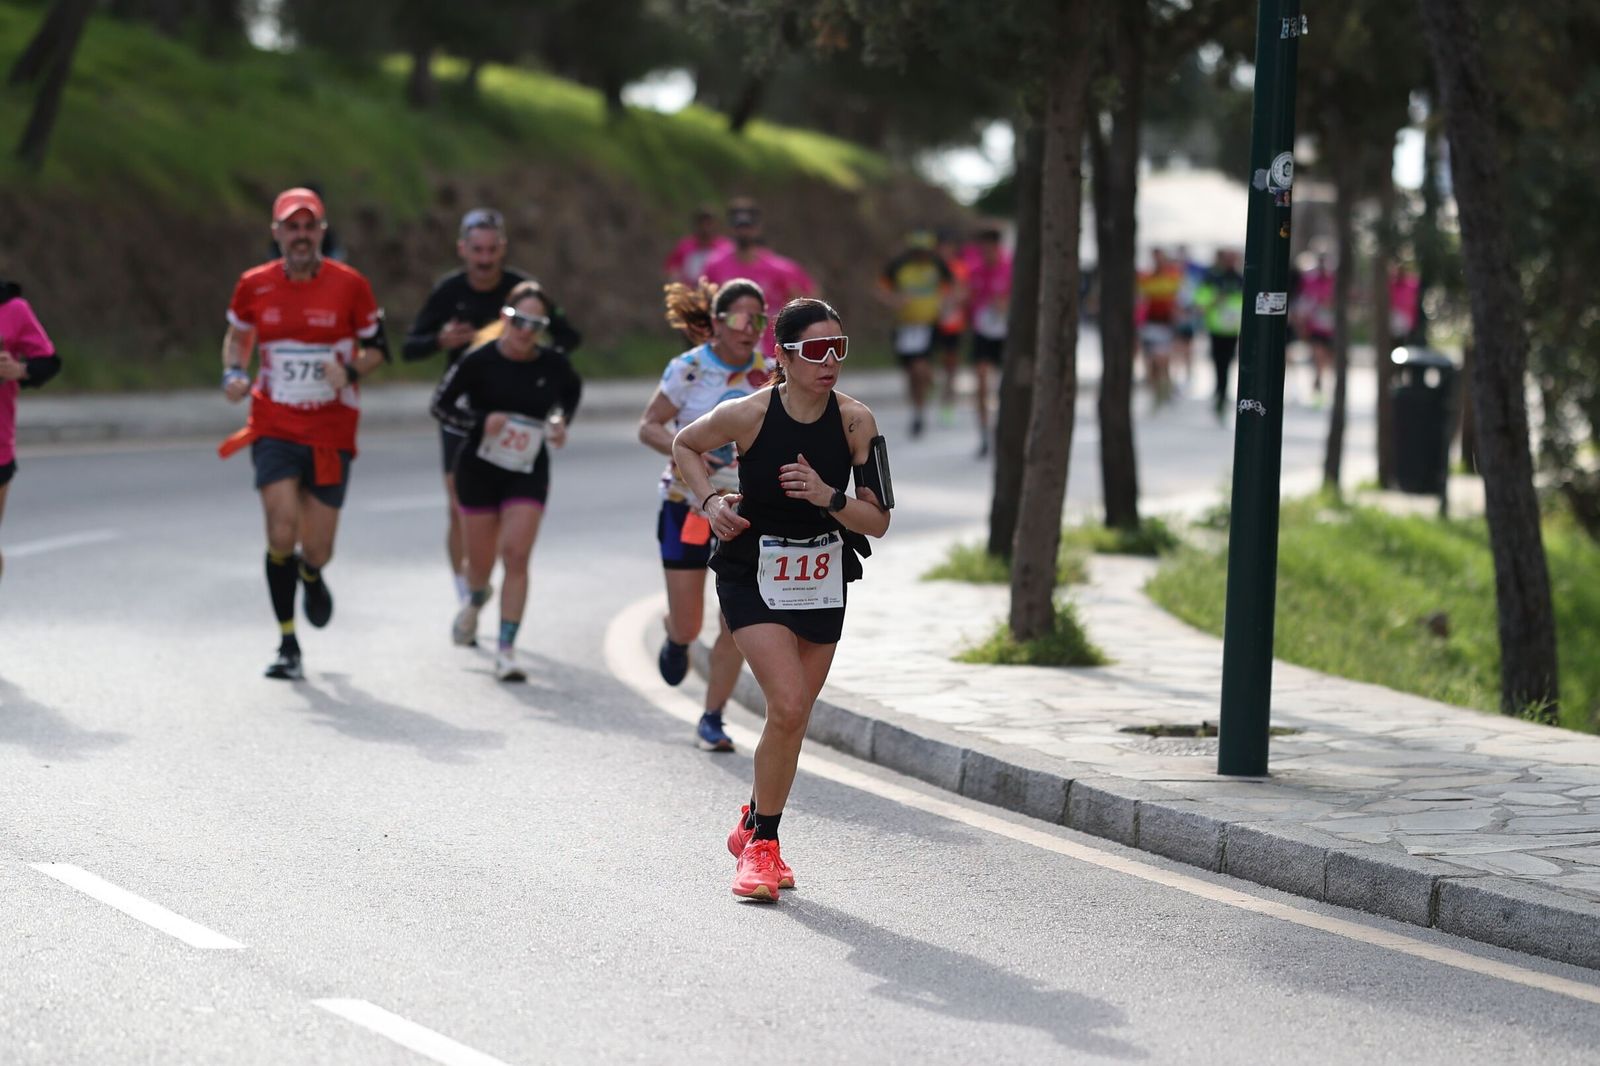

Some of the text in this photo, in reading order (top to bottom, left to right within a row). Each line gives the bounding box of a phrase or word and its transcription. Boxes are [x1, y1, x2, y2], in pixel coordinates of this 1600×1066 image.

[282, 360, 326, 382] 578
[500, 427, 531, 453] 20
[773, 553, 830, 581] 118
